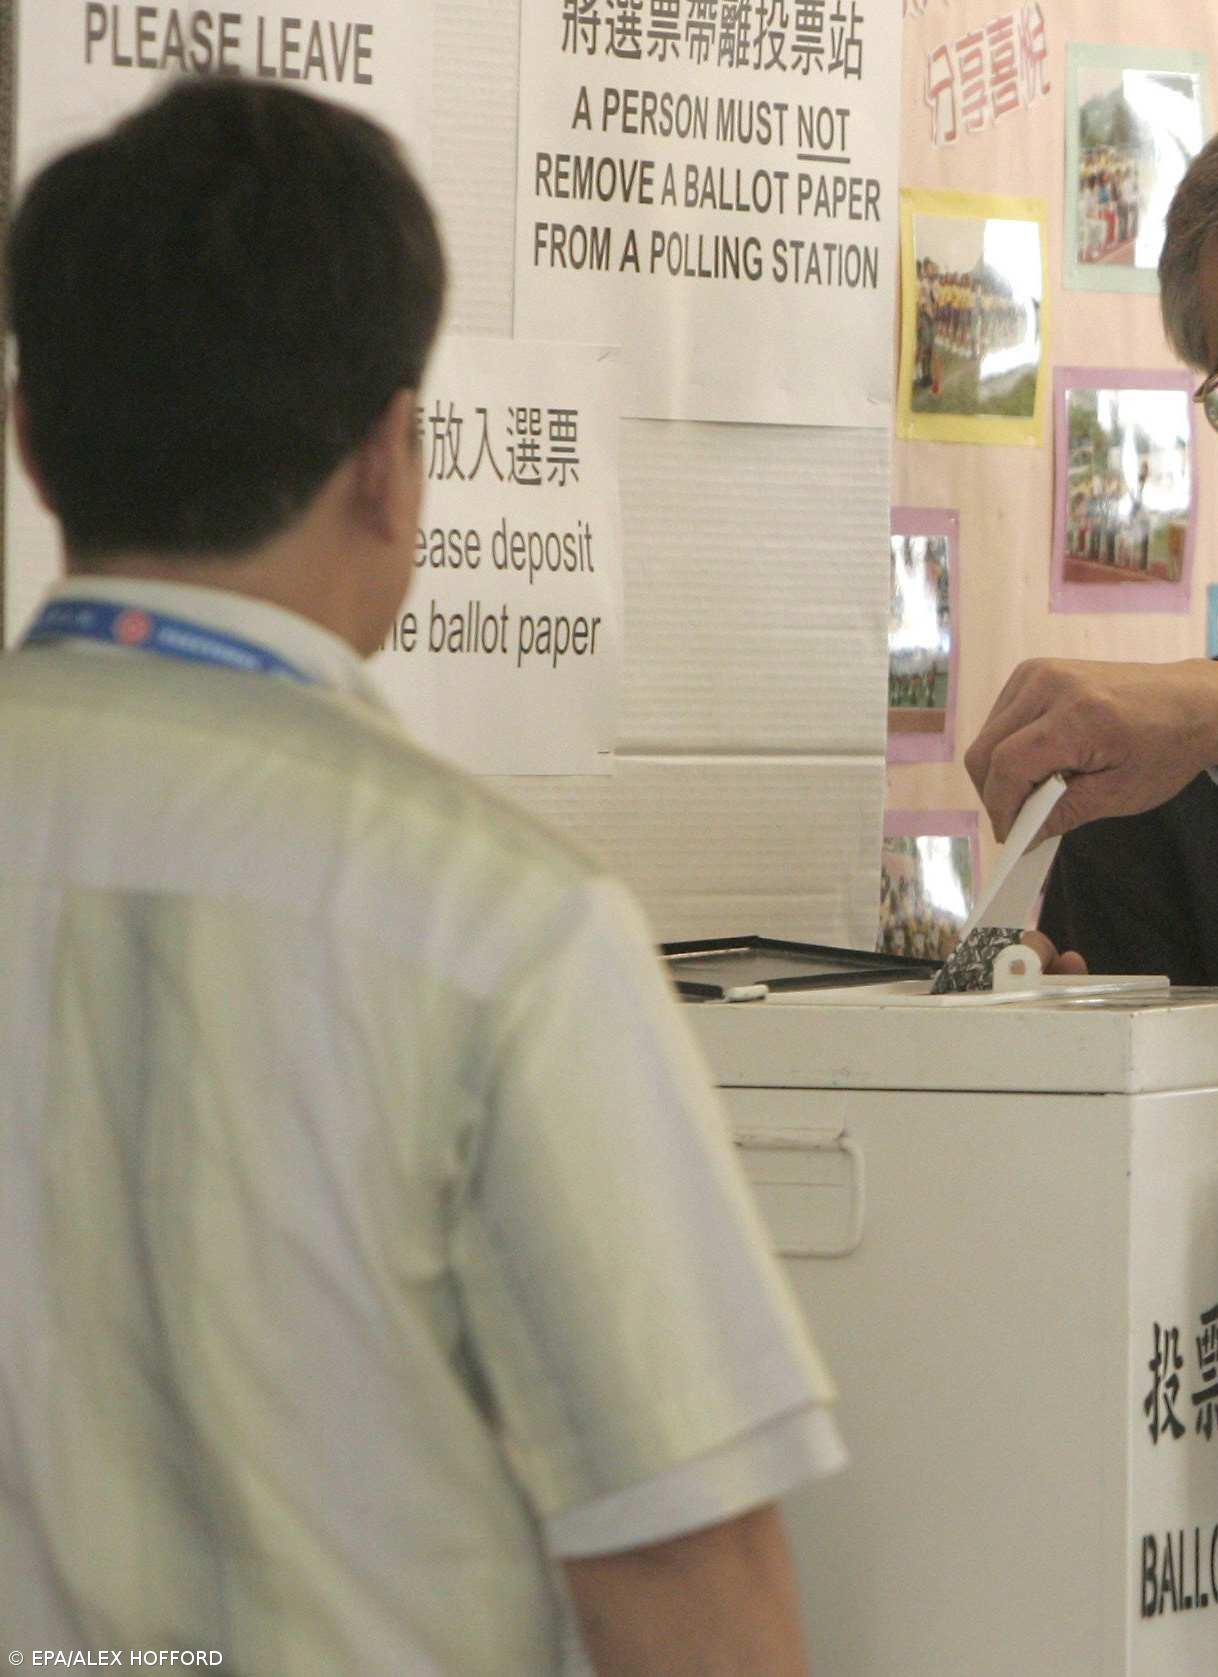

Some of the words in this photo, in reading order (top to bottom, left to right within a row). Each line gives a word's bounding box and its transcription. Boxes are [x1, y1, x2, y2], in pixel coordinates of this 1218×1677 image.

[84, 2, 243, 74] PLEASE
[256, 15, 374, 85] LEAVE
[572, 86, 592, 130] A
[602, 88, 708, 140] PERSON
[716, 98, 789, 146] MUST
[797, 104, 851, 151] NOT
[535, 152, 655, 204] REMOVE
[660, 163, 677, 207] A
[684, 164, 789, 214] BALLOT
[797, 173, 881, 222] PAPER
[533, 222, 611, 272] FROM
[618, 229, 641, 273] A
[650, 230, 763, 281] POLLING
[771, 239, 879, 289] STATION
[413, 527, 481, 569] ease
[491, 518, 594, 585] deposit
[429, 600, 508, 654] ballot
[517, 615, 601, 668] paper
